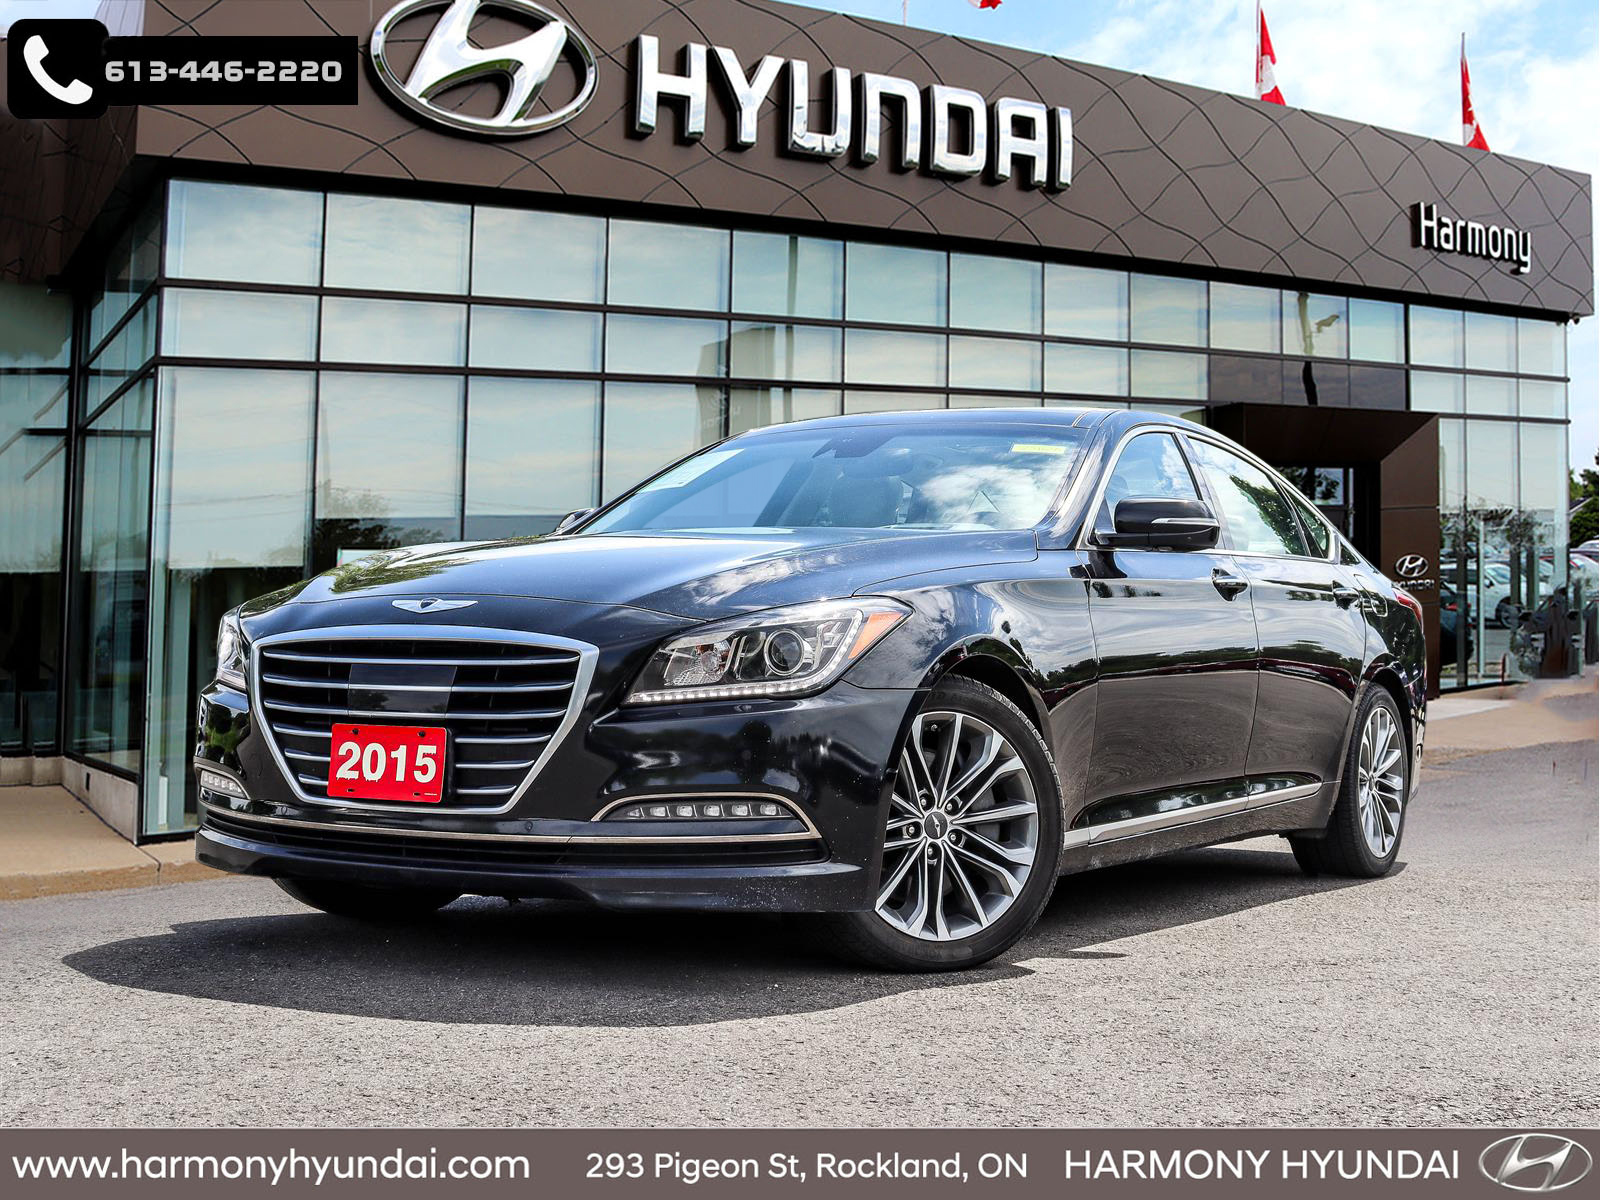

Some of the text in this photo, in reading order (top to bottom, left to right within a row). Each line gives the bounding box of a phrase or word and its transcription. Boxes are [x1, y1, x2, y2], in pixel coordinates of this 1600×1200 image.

[635, 34, 1073, 190] HYUNDAI
[1419, 201, 1532, 274] Harmony
[336, 741, 438, 784] 2015
